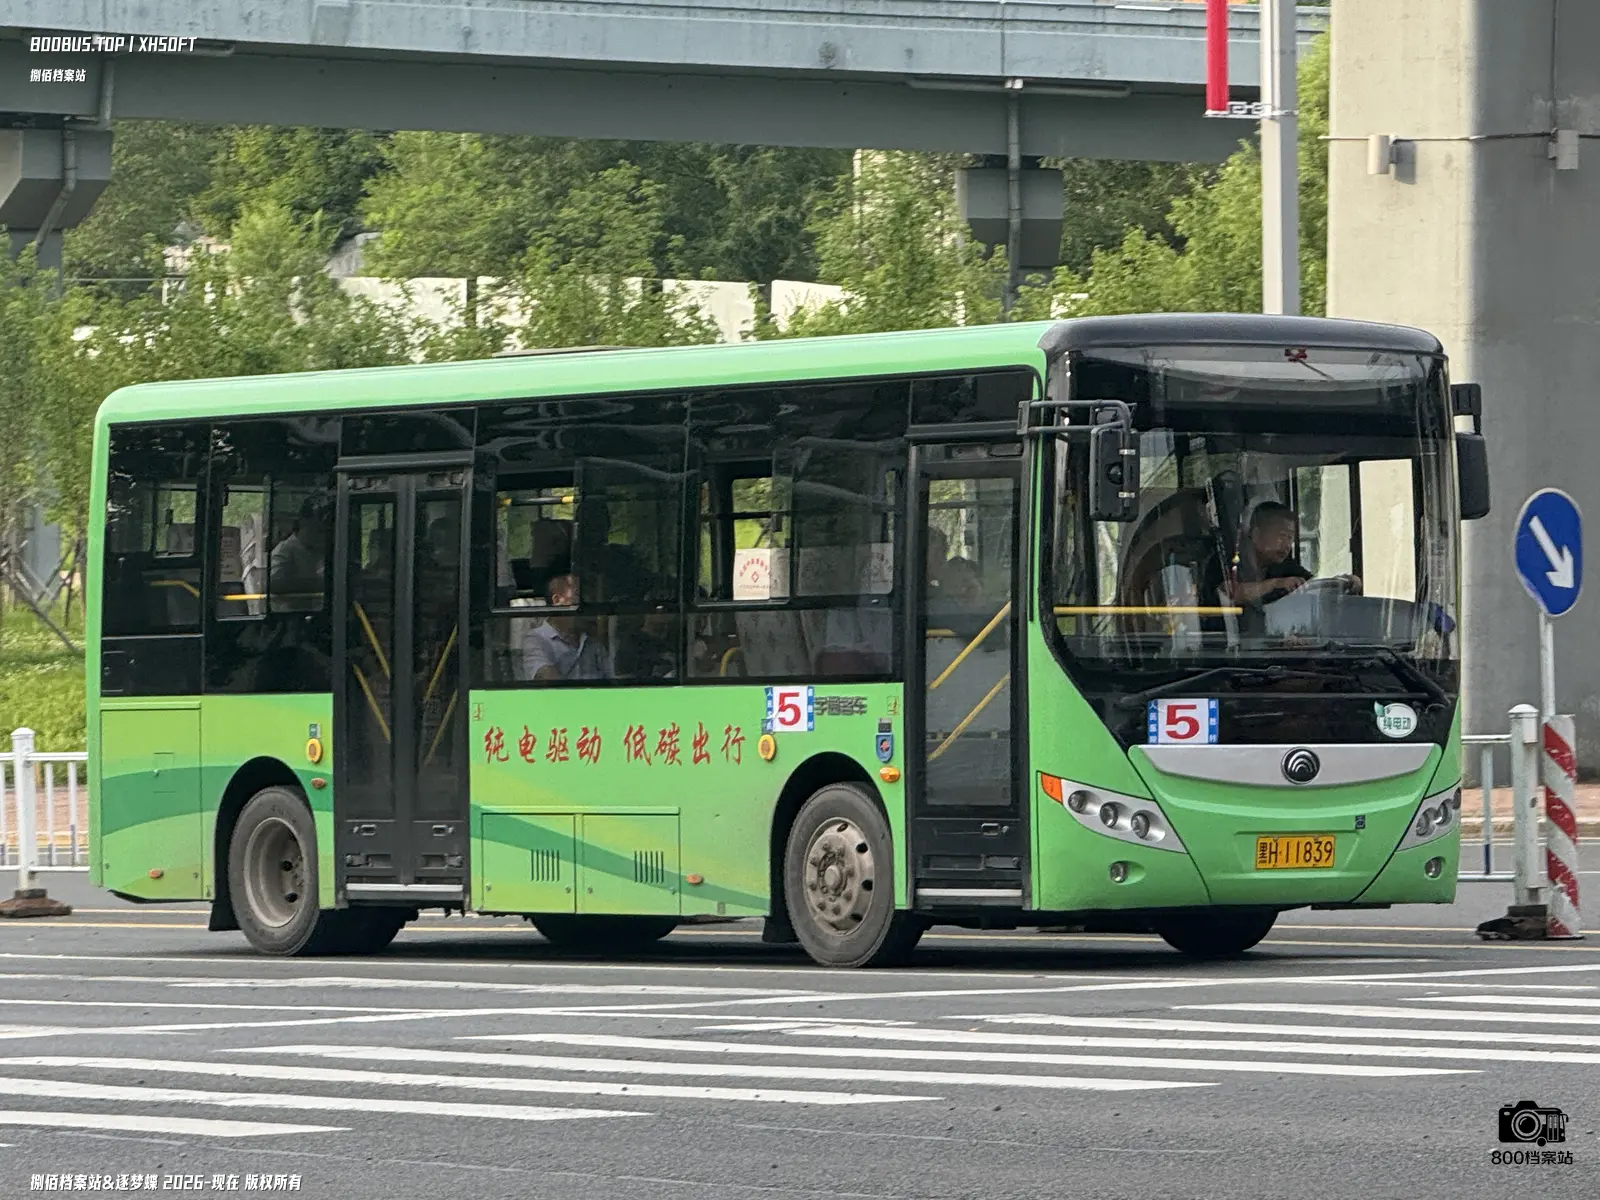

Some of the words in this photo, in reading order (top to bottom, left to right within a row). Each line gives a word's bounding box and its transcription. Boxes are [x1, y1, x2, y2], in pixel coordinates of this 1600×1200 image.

[778, 692, 801, 726] 5
[1165, 704, 1200, 739] 5
[483, 724, 602, 765] 纯电驱动
[623, 721, 747, 767] 低碳出行
